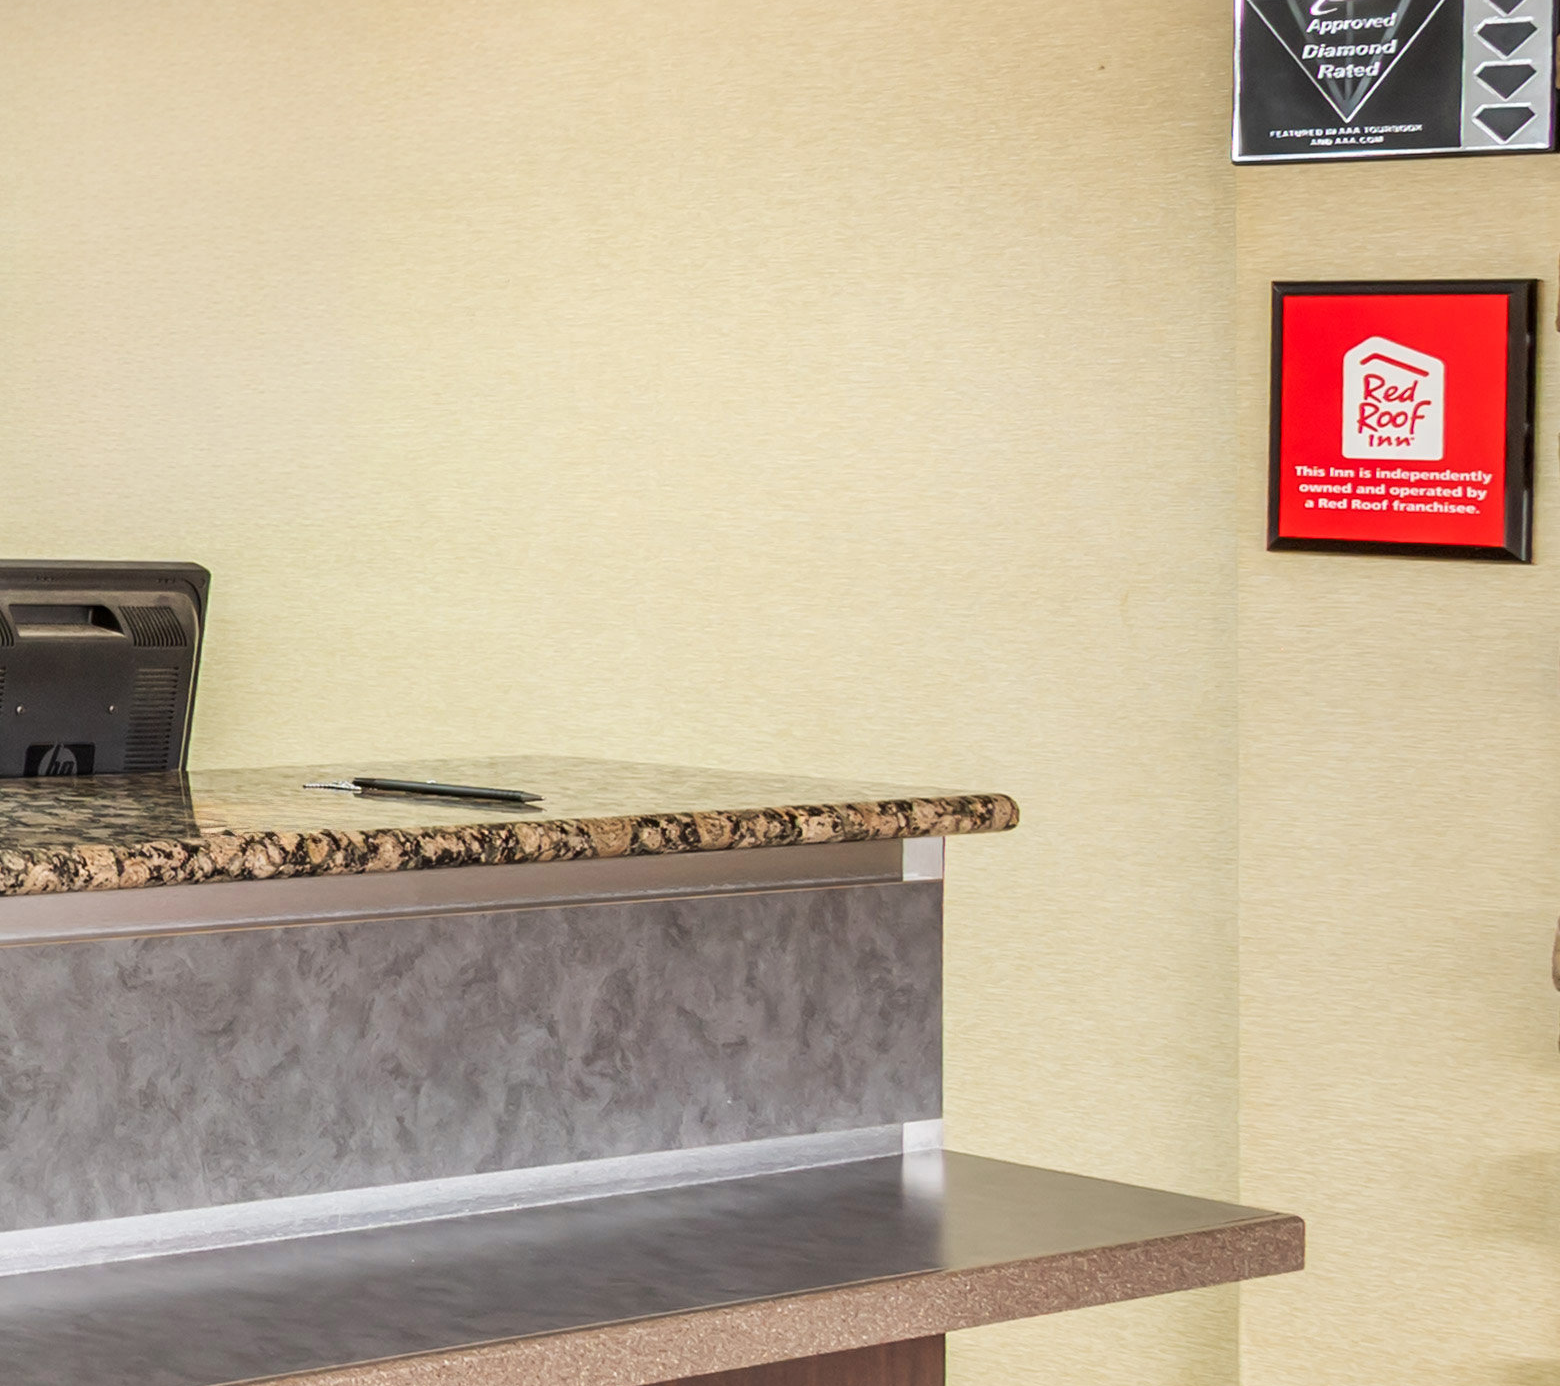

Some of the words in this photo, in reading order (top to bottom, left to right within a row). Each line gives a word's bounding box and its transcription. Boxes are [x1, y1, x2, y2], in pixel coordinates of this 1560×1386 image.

[1307, 13, 1397, 35] Approved
[1302, 40, 1396, 60] Diamond
[1318, 62, 1380, 80] Rated
[1269, 128, 1323, 138] FEATURED
[1338, 127, 1360, 135] AAA
[1363, 374, 1418, 402] Red
[1358, 401, 1431, 434] Roof
[1295, 466, 1325, 477] This
[1330, 467, 1354, 478] Inn
[1359, 468, 1371, 478] is
[1376, 468, 1492, 484] independently
[1299, 483, 1352, 494] owned
[1356, 484, 1385, 495] and
[1389, 485, 1462, 498] operated
[1467, 487, 1487, 500] by
[1305, 500, 1313, 509] a
[1318, 498, 1347, 509] Red
[1352, 499, 1389, 510] Roof
[1392, 500, 1480, 514] franchisee.
